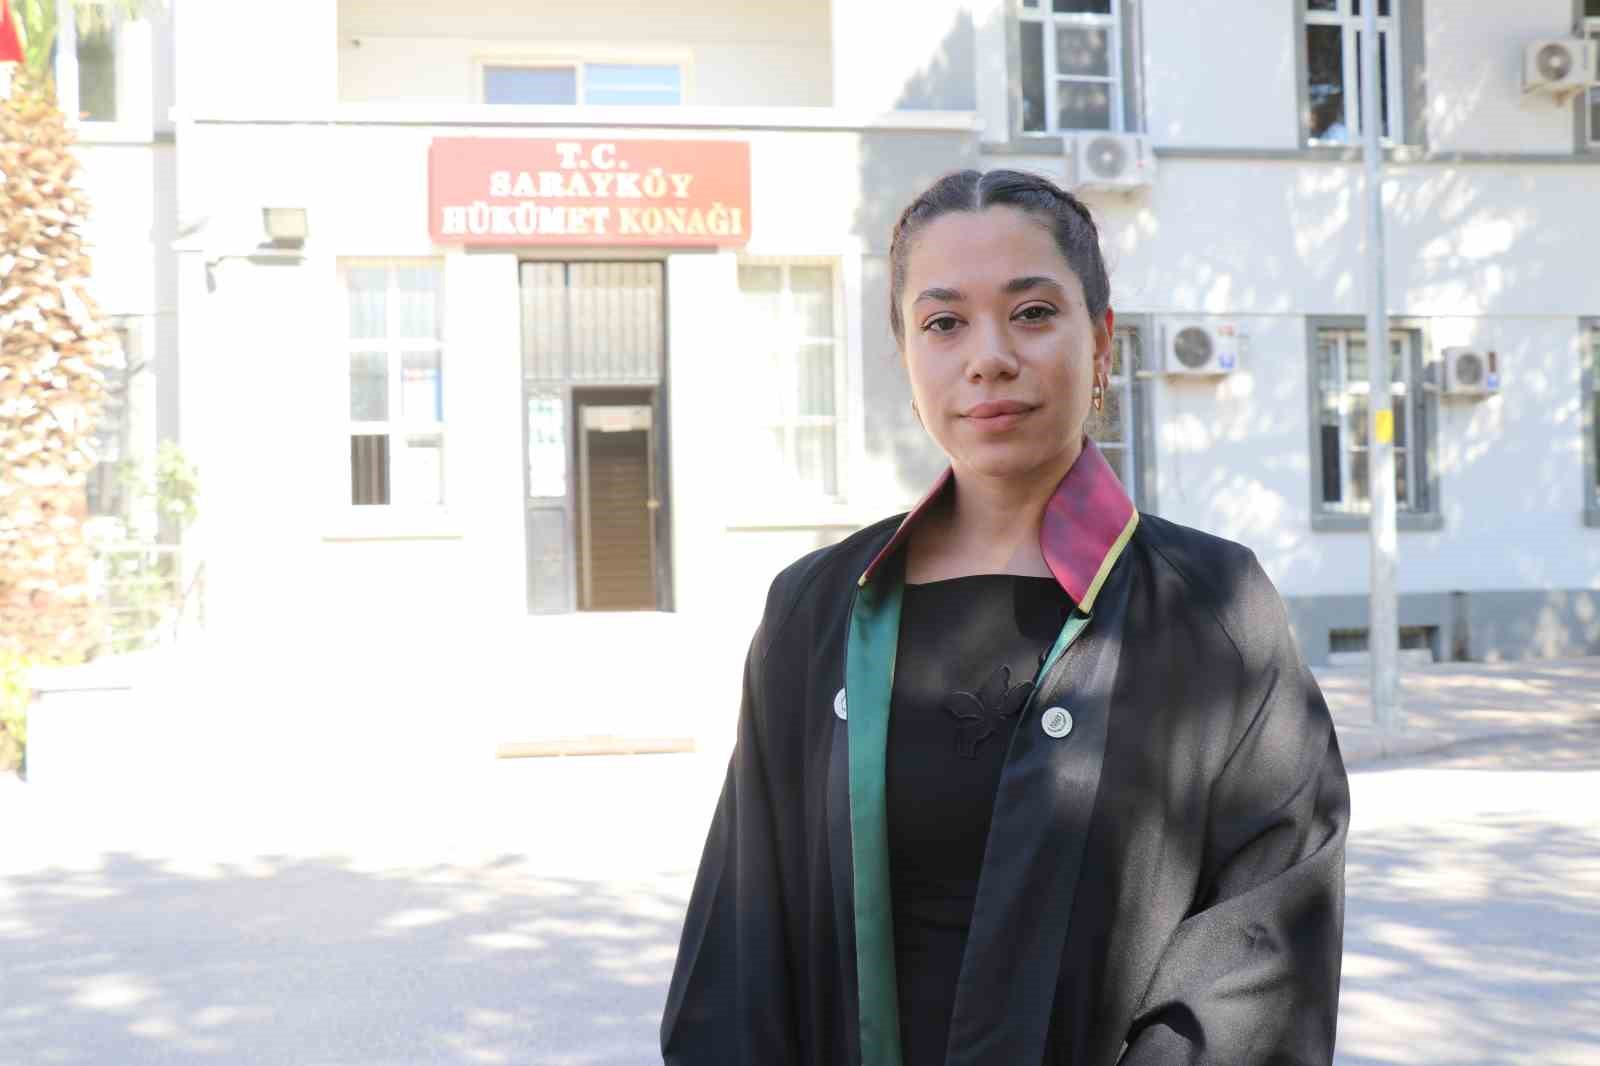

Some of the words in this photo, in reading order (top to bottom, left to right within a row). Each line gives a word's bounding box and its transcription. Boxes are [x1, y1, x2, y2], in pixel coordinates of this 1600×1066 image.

[489, 168, 693, 198] SARAYKÖY
[441, 201, 610, 235] HÜKÜMET
[618, 202, 743, 236] KONAĞI
